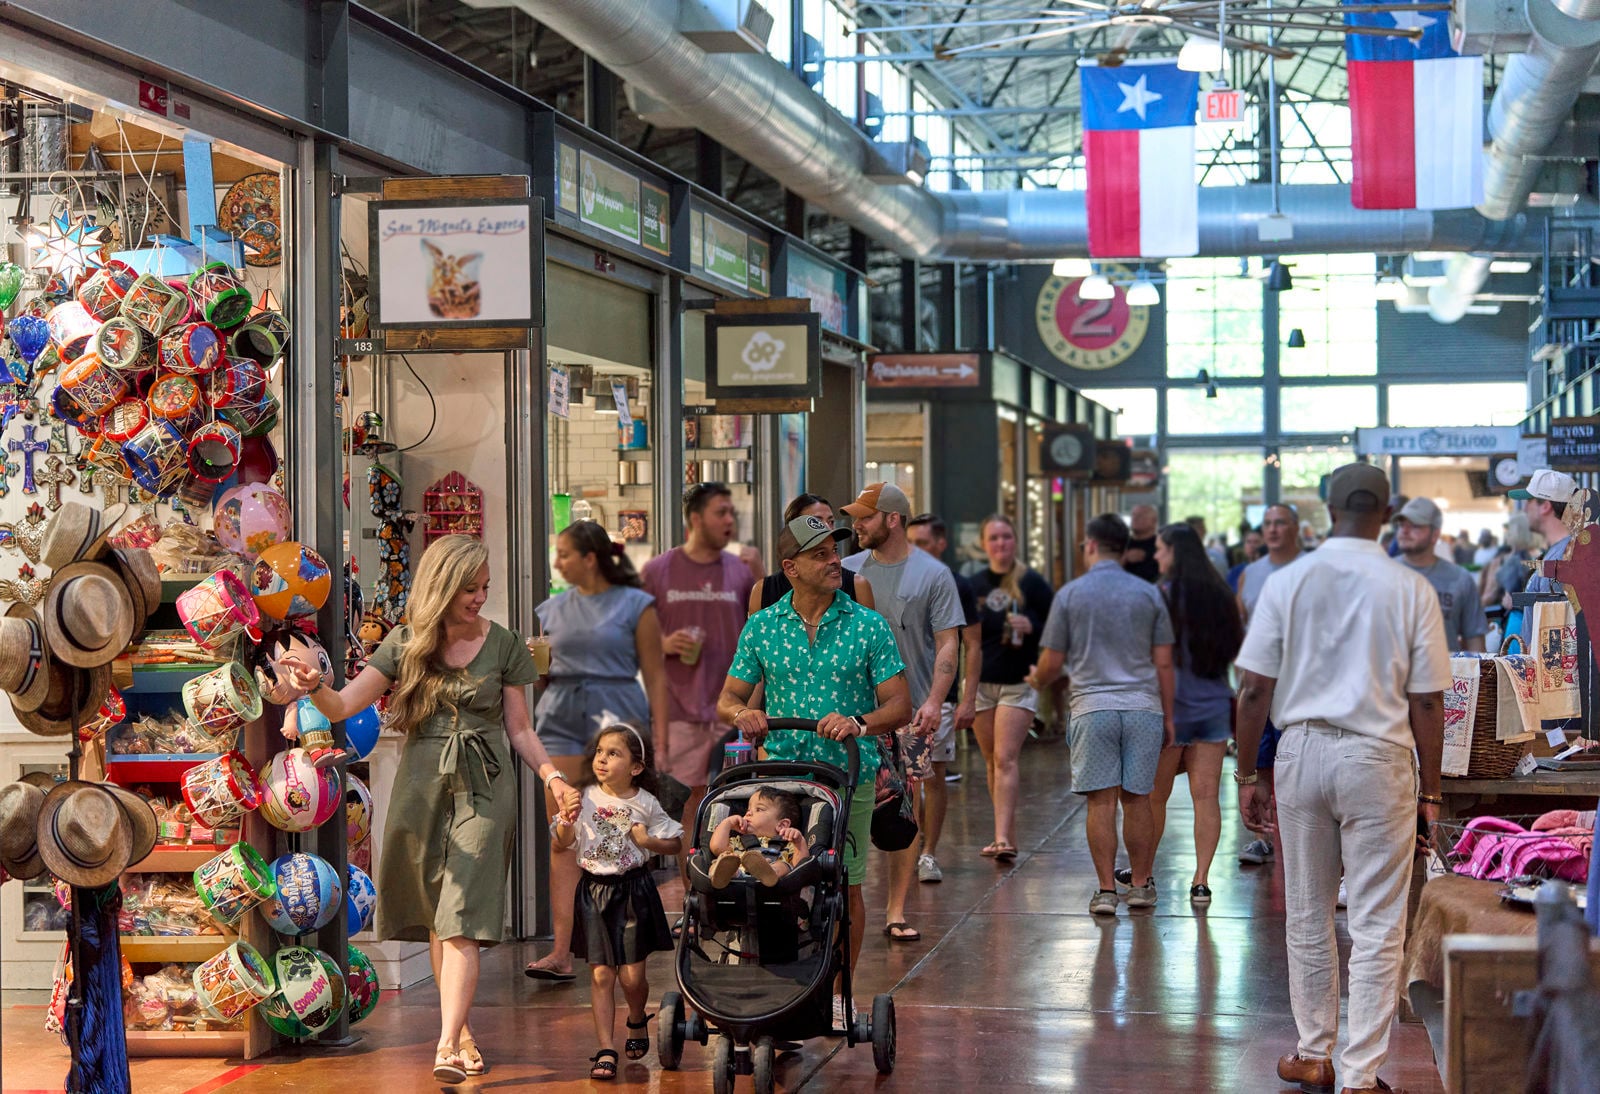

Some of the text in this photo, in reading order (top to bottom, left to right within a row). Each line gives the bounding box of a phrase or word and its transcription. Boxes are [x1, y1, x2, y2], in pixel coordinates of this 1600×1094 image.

[1206, 93, 1239, 119] EXIT
[382, 220, 413, 236] San
[418, 218, 473, 234] Miguel's
[1071, 293, 1116, 338] 2
[354, 342, 373, 352] 183
[1054, 340, 1131, 366] DALLAS
[1552, 425, 1594, 438] BEYOND
[1446, 434, 1497, 449] SEAFOOD
[666, 583, 737, 603] Steamboat
[1452, 678, 1469, 694] XAS
